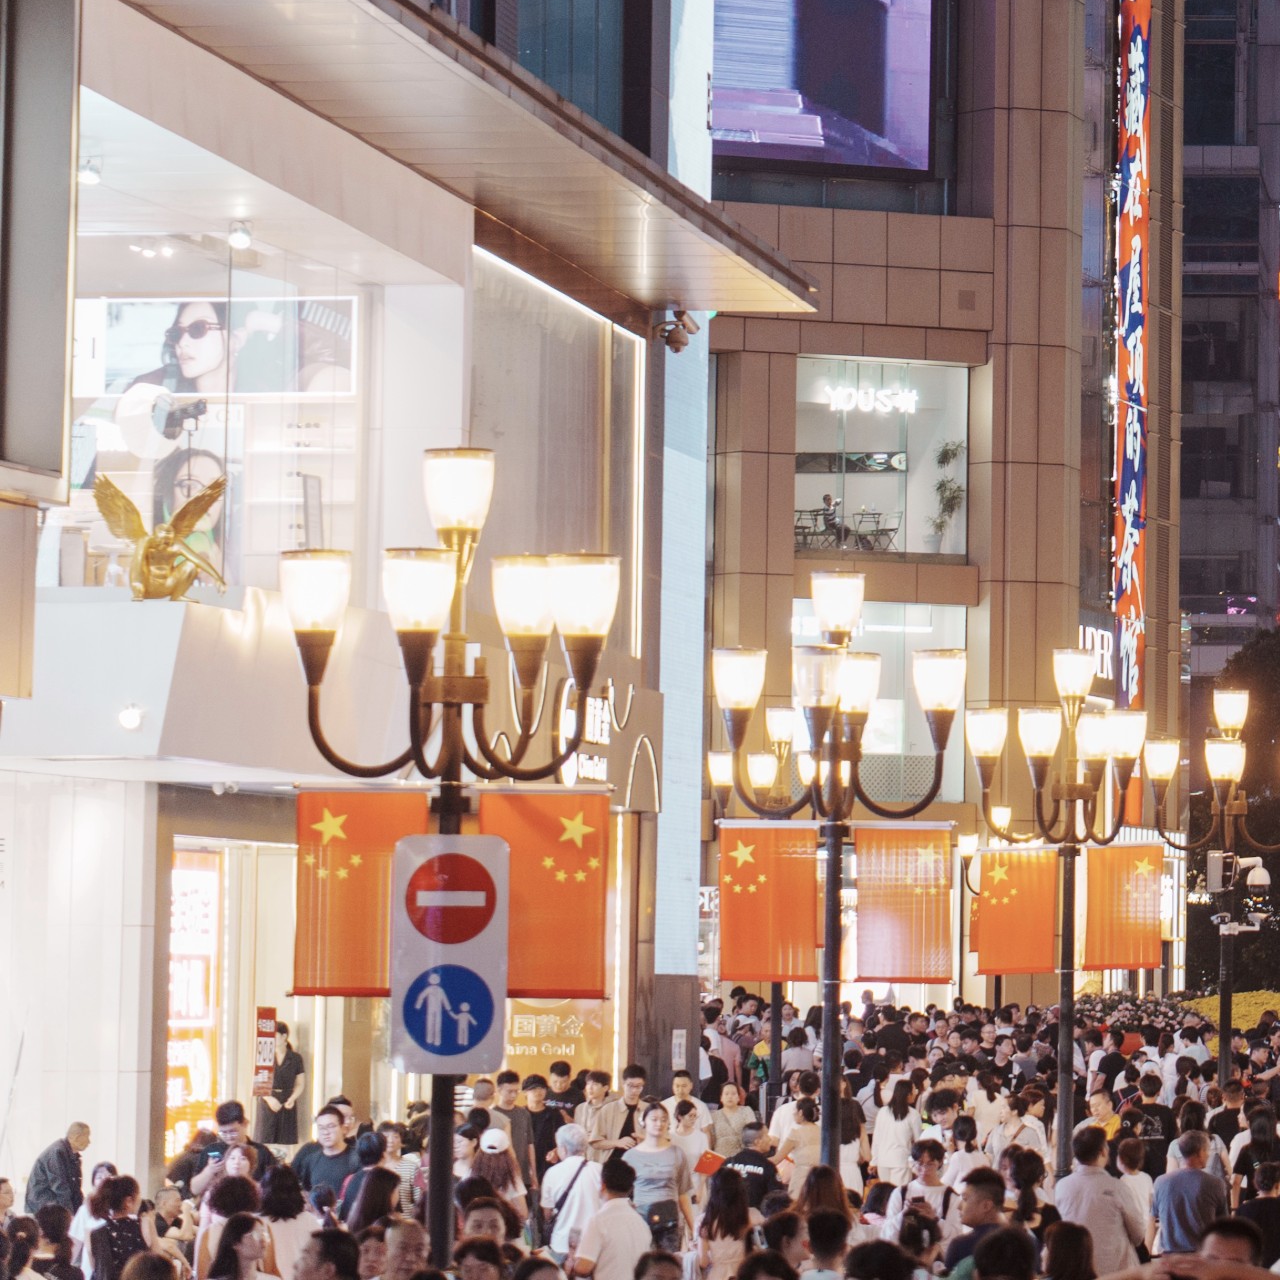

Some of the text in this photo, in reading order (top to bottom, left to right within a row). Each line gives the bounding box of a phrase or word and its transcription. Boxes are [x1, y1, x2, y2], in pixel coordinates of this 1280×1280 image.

[505, 1014, 584, 1038] 国黄金
[506, 1043, 575, 1056] hina Gold
